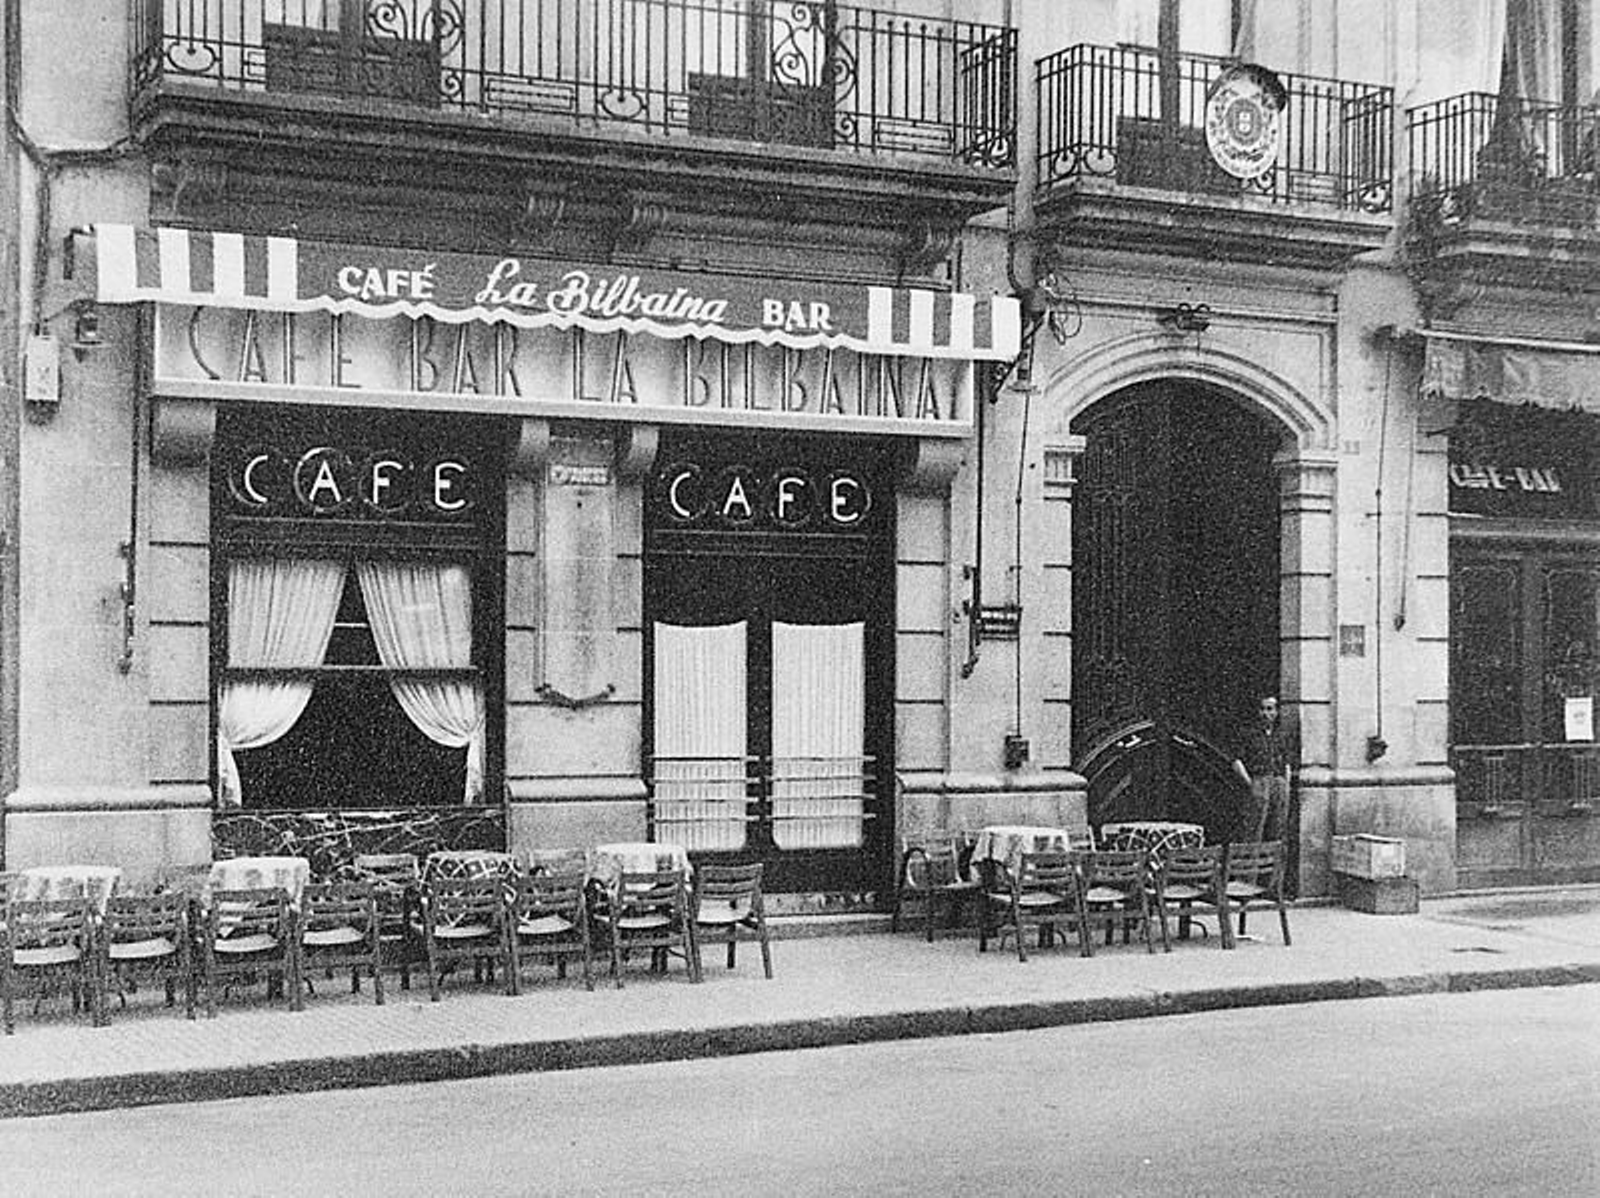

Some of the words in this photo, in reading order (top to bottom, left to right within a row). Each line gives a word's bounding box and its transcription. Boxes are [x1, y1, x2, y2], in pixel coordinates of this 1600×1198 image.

[337, 264, 436, 299] CAFÉ
[475, 258, 537, 304] La
[762, 297, 834, 333] BAR
[188, 304, 361, 387] CAFE
[410, 315, 521, 396] BAR
[572, 325, 638, 403] LA
[685, 337, 940, 420] BILBAINA
[244, 455, 466, 509] CAFE
[669, 472, 859, 522] CAFE
